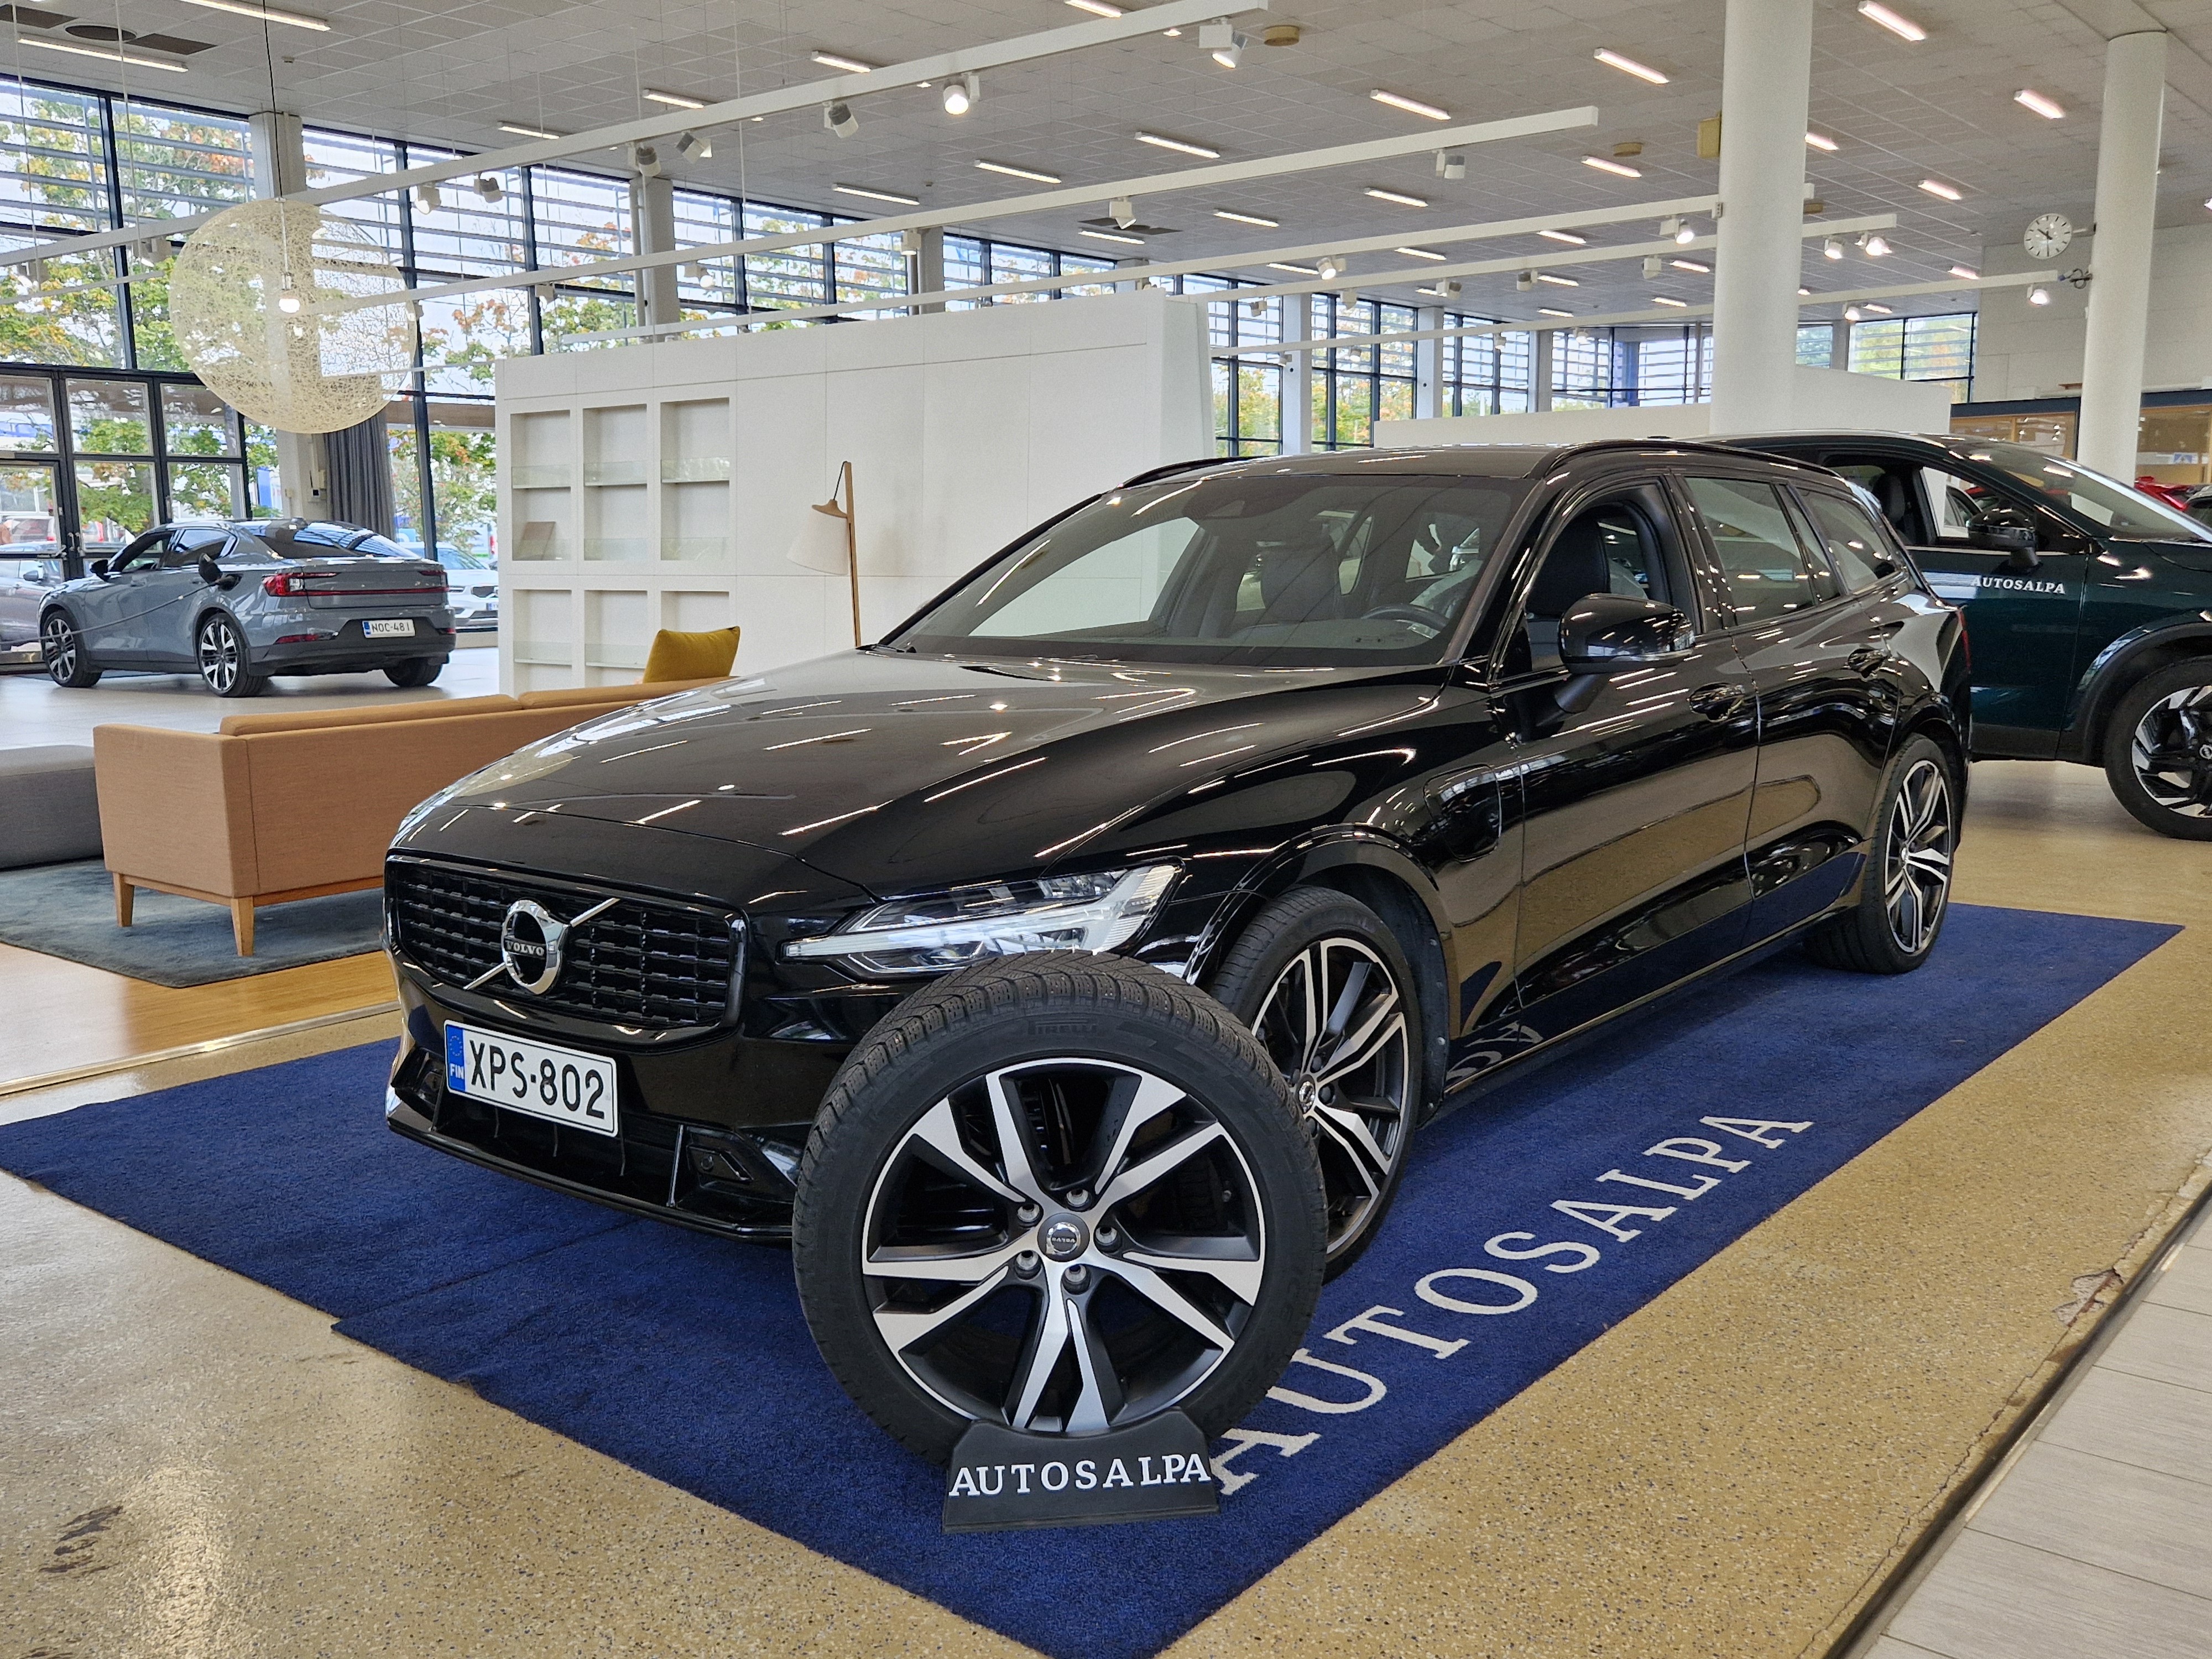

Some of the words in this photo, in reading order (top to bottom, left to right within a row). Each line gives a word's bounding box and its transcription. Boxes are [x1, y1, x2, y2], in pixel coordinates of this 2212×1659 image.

[1970, 577, 2067, 594] AUTOSALPA
[371, 622, 410, 633] NOC-481
[504, 940, 545, 956] VOLVO
[449, 1063, 465, 1079] FIN
[469, 1039, 605, 1119] XPS-802
[1209, 1114, 1813, 1495] AUTOSALPA
[948, 1453, 1212, 1496] AUTOSALPA
